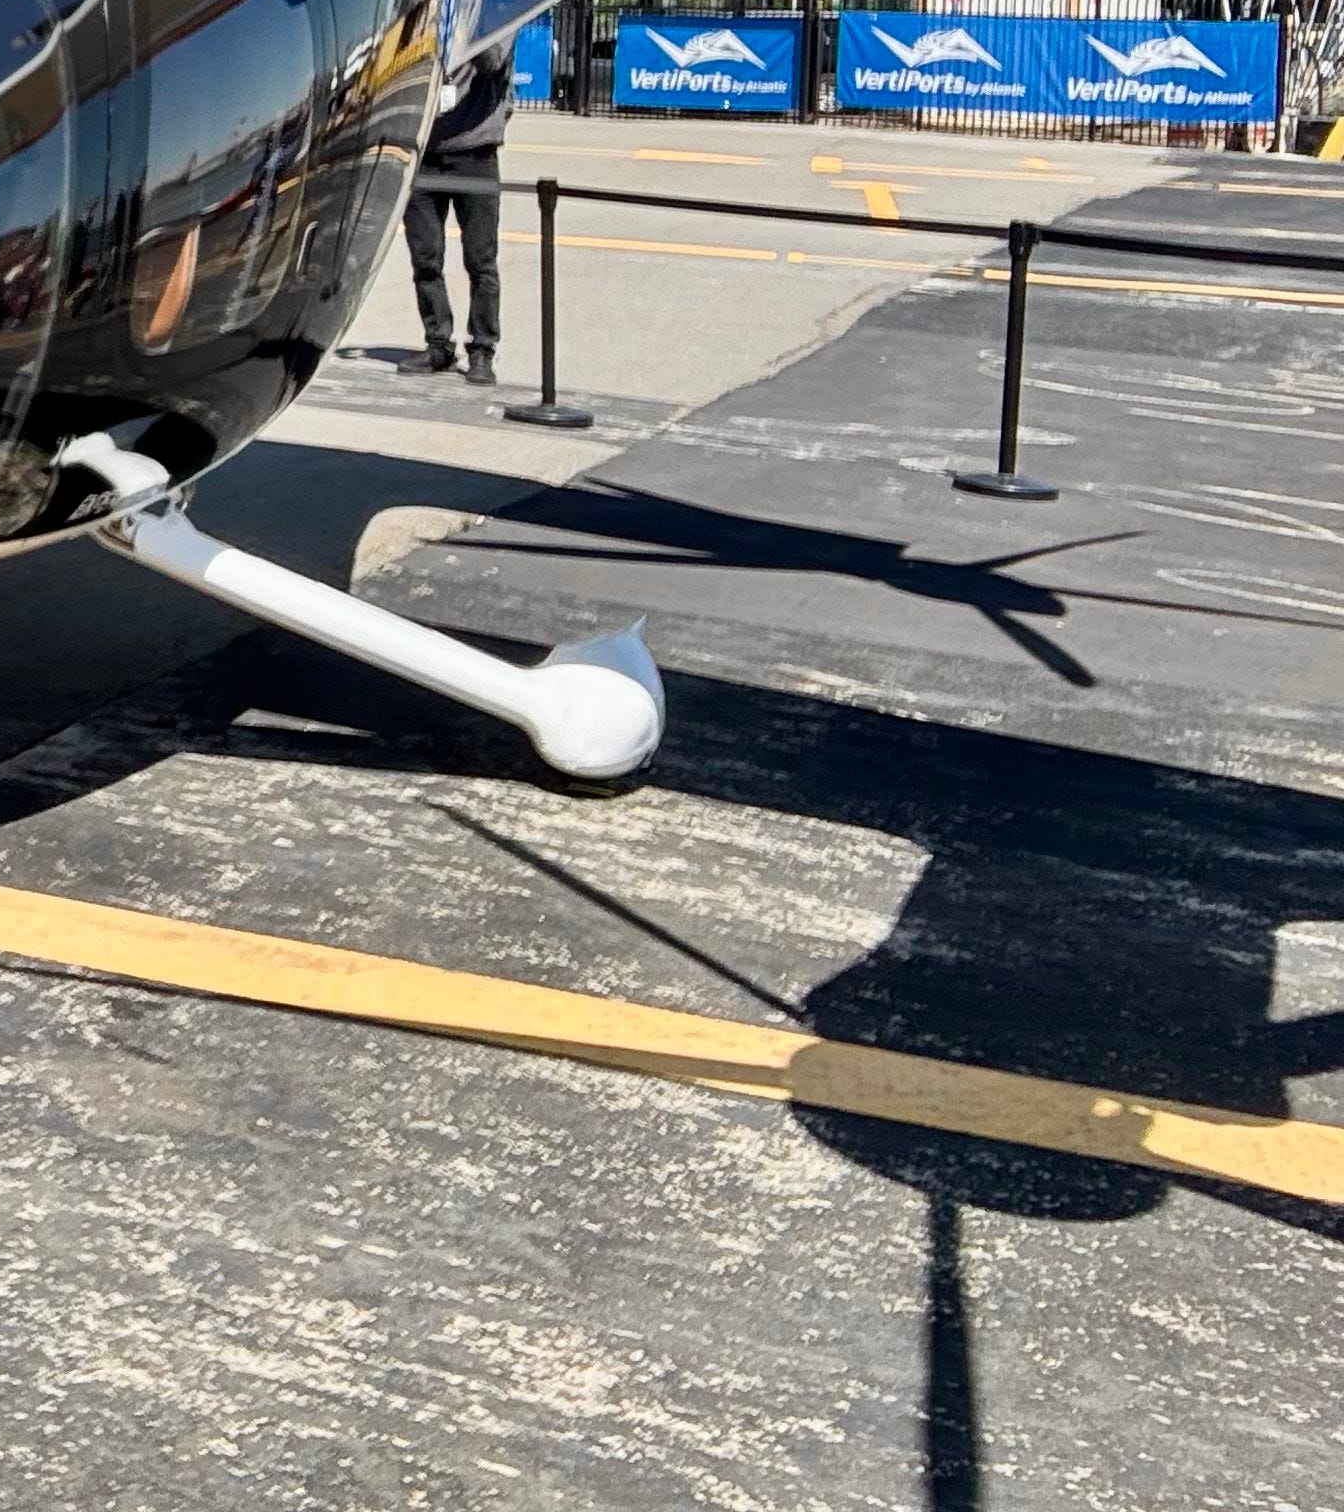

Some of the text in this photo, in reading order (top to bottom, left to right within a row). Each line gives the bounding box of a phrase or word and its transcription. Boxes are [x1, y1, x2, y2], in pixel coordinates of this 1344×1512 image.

[630, 67, 788, 95] VertiPorts by Atlantic
[854, 67, 1027, 97] VertiPorts by Atlantic
[1067, 76, 1254, 106] VertiPorts by Atlantic
